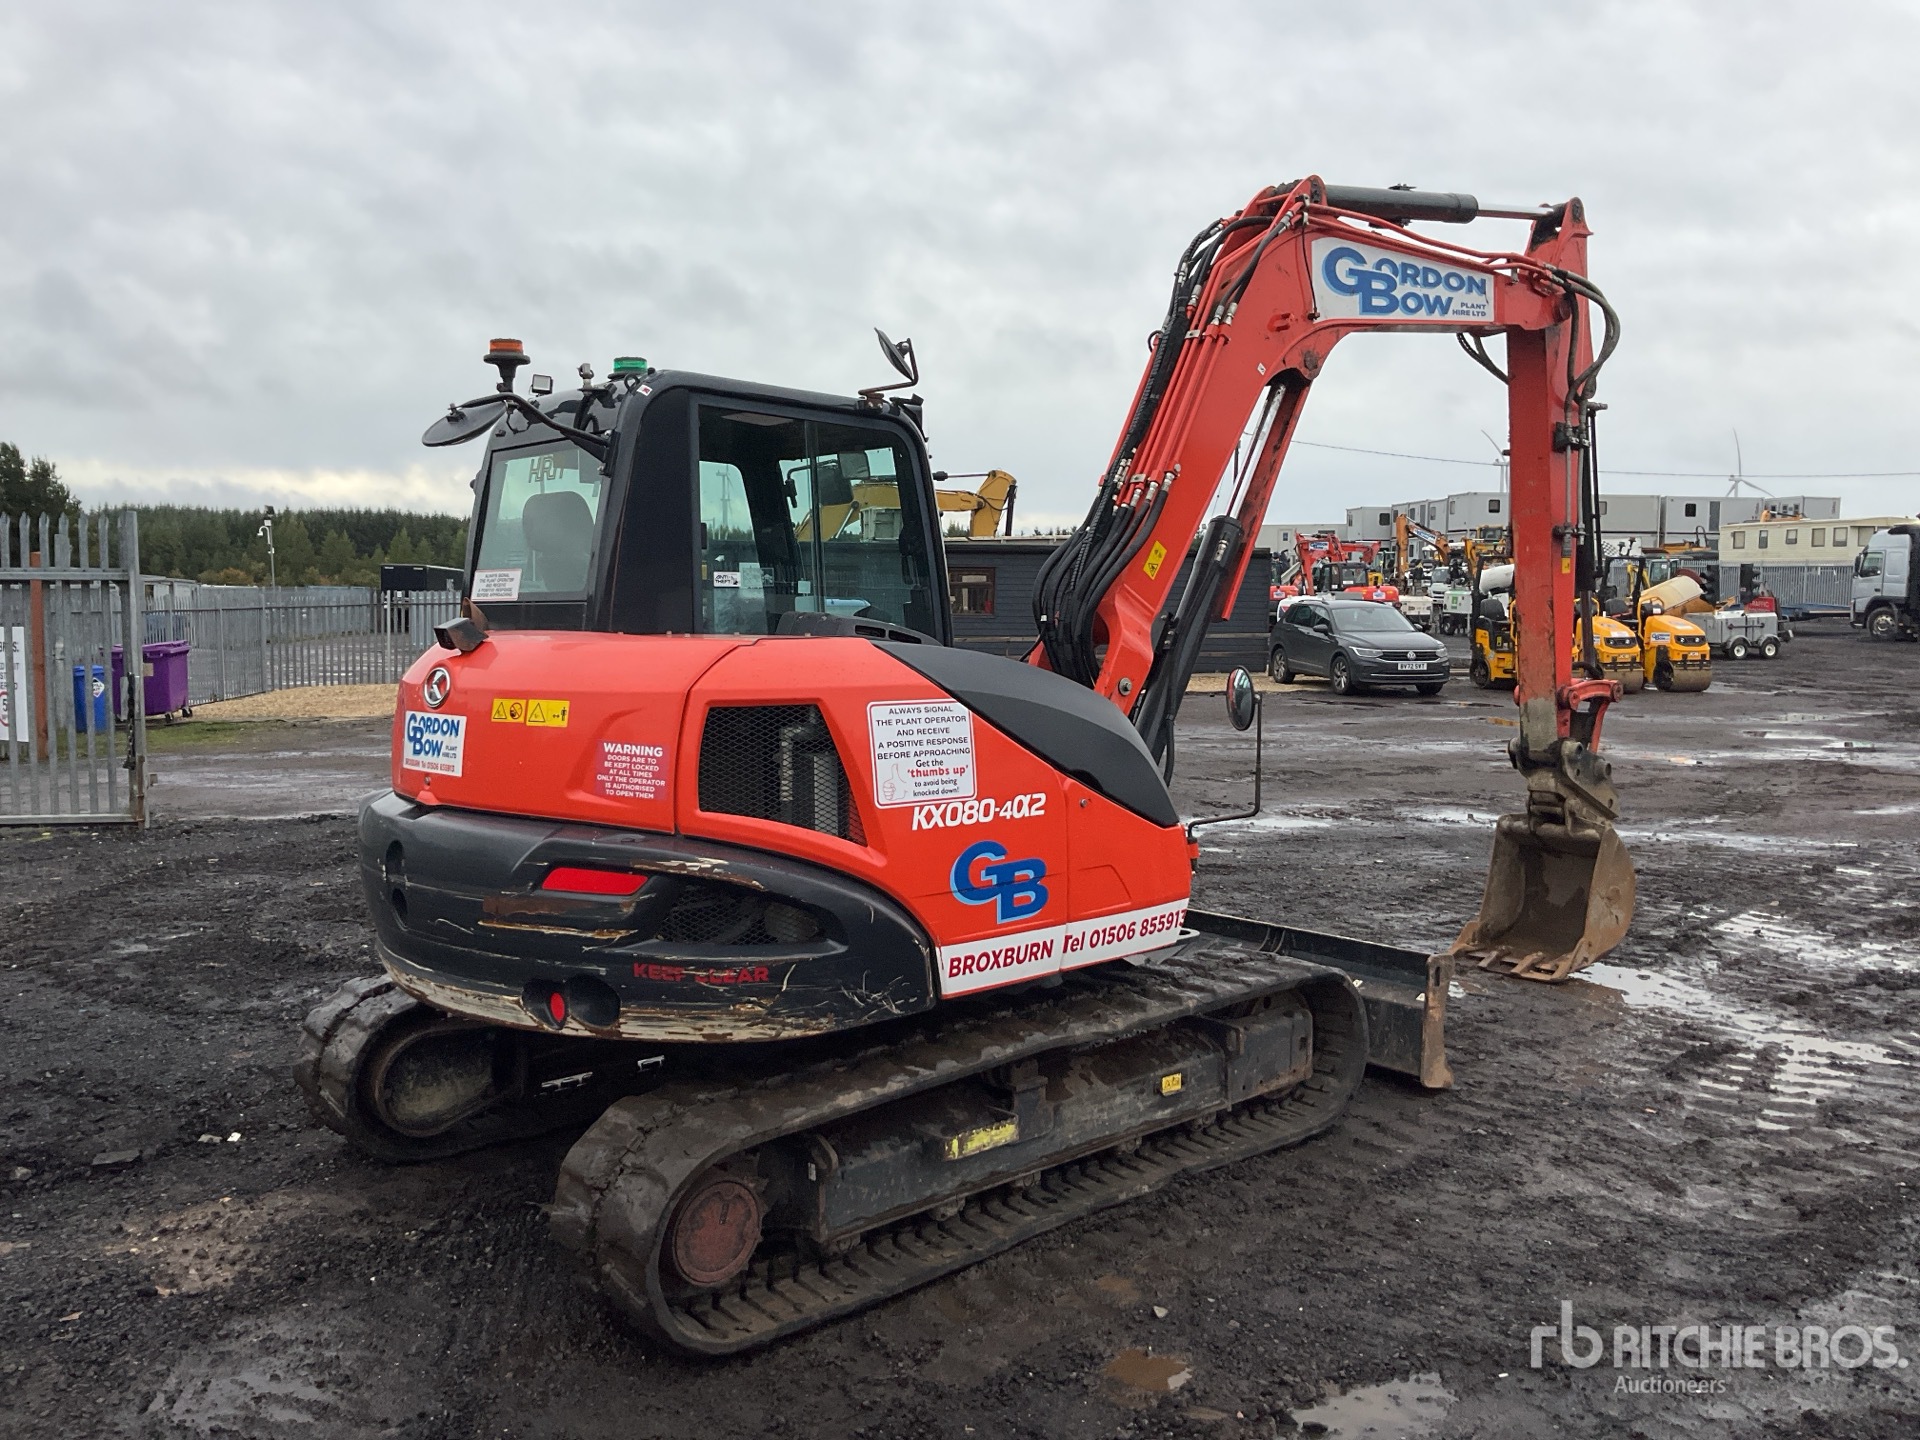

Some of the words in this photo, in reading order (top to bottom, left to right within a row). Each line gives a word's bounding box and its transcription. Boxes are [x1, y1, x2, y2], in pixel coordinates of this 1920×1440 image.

[1322, 247, 1486, 296] GORDON
[1346, 268, 1453, 315] BOW
[1460, 302, 1486, 310] PLANT
[1472, 309, 1486, 317] LTD
[889, 706, 922, 715] ALWAYS
[876, 719, 893, 727] THE
[895, 717, 922, 725] PLANT
[924, 715, 967, 724] OPERATOR
[407, 713, 460, 742] GORDON
[897, 729, 914, 737] AND
[916, 727, 950, 735] RECEIVE
[412, 726, 444, 757] BOW
[887, 740, 924, 748] POSITIVE
[926, 737, 968, 745] RESPONSE
[604, 743, 663, 757] WARNING
[877, 751, 911, 760] BEFORE
[913, 747, 970, 758] APPROACHING
[647, 757, 657, 765] TO
[916, 760, 930, 768] Get
[931, 759, 944, 767] the
[631, 764, 660, 772] LOCKED
[632, 770, 653, 778] TIMES
[615, 775, 628, 783] THE
[628, 777, 666, 786] OPERATOR
[923, 779, 940, 787] avoid
[940, 778, 958, 786] being
[613, 783, 655, 792] AUTHORISED
[913, 788, 939, 797] knocked
[940, 787, 959, 795] down!
[635, 791, 654, 799] THEM
[949, 839, 1049, 925] GB
[948, 939, 1054, 978] BROXBURN
[1062, 931, 1086, 954] Tel
[1089, 921, 1137, 949] 01506
[1139, 909, 1187, 937] 855913
